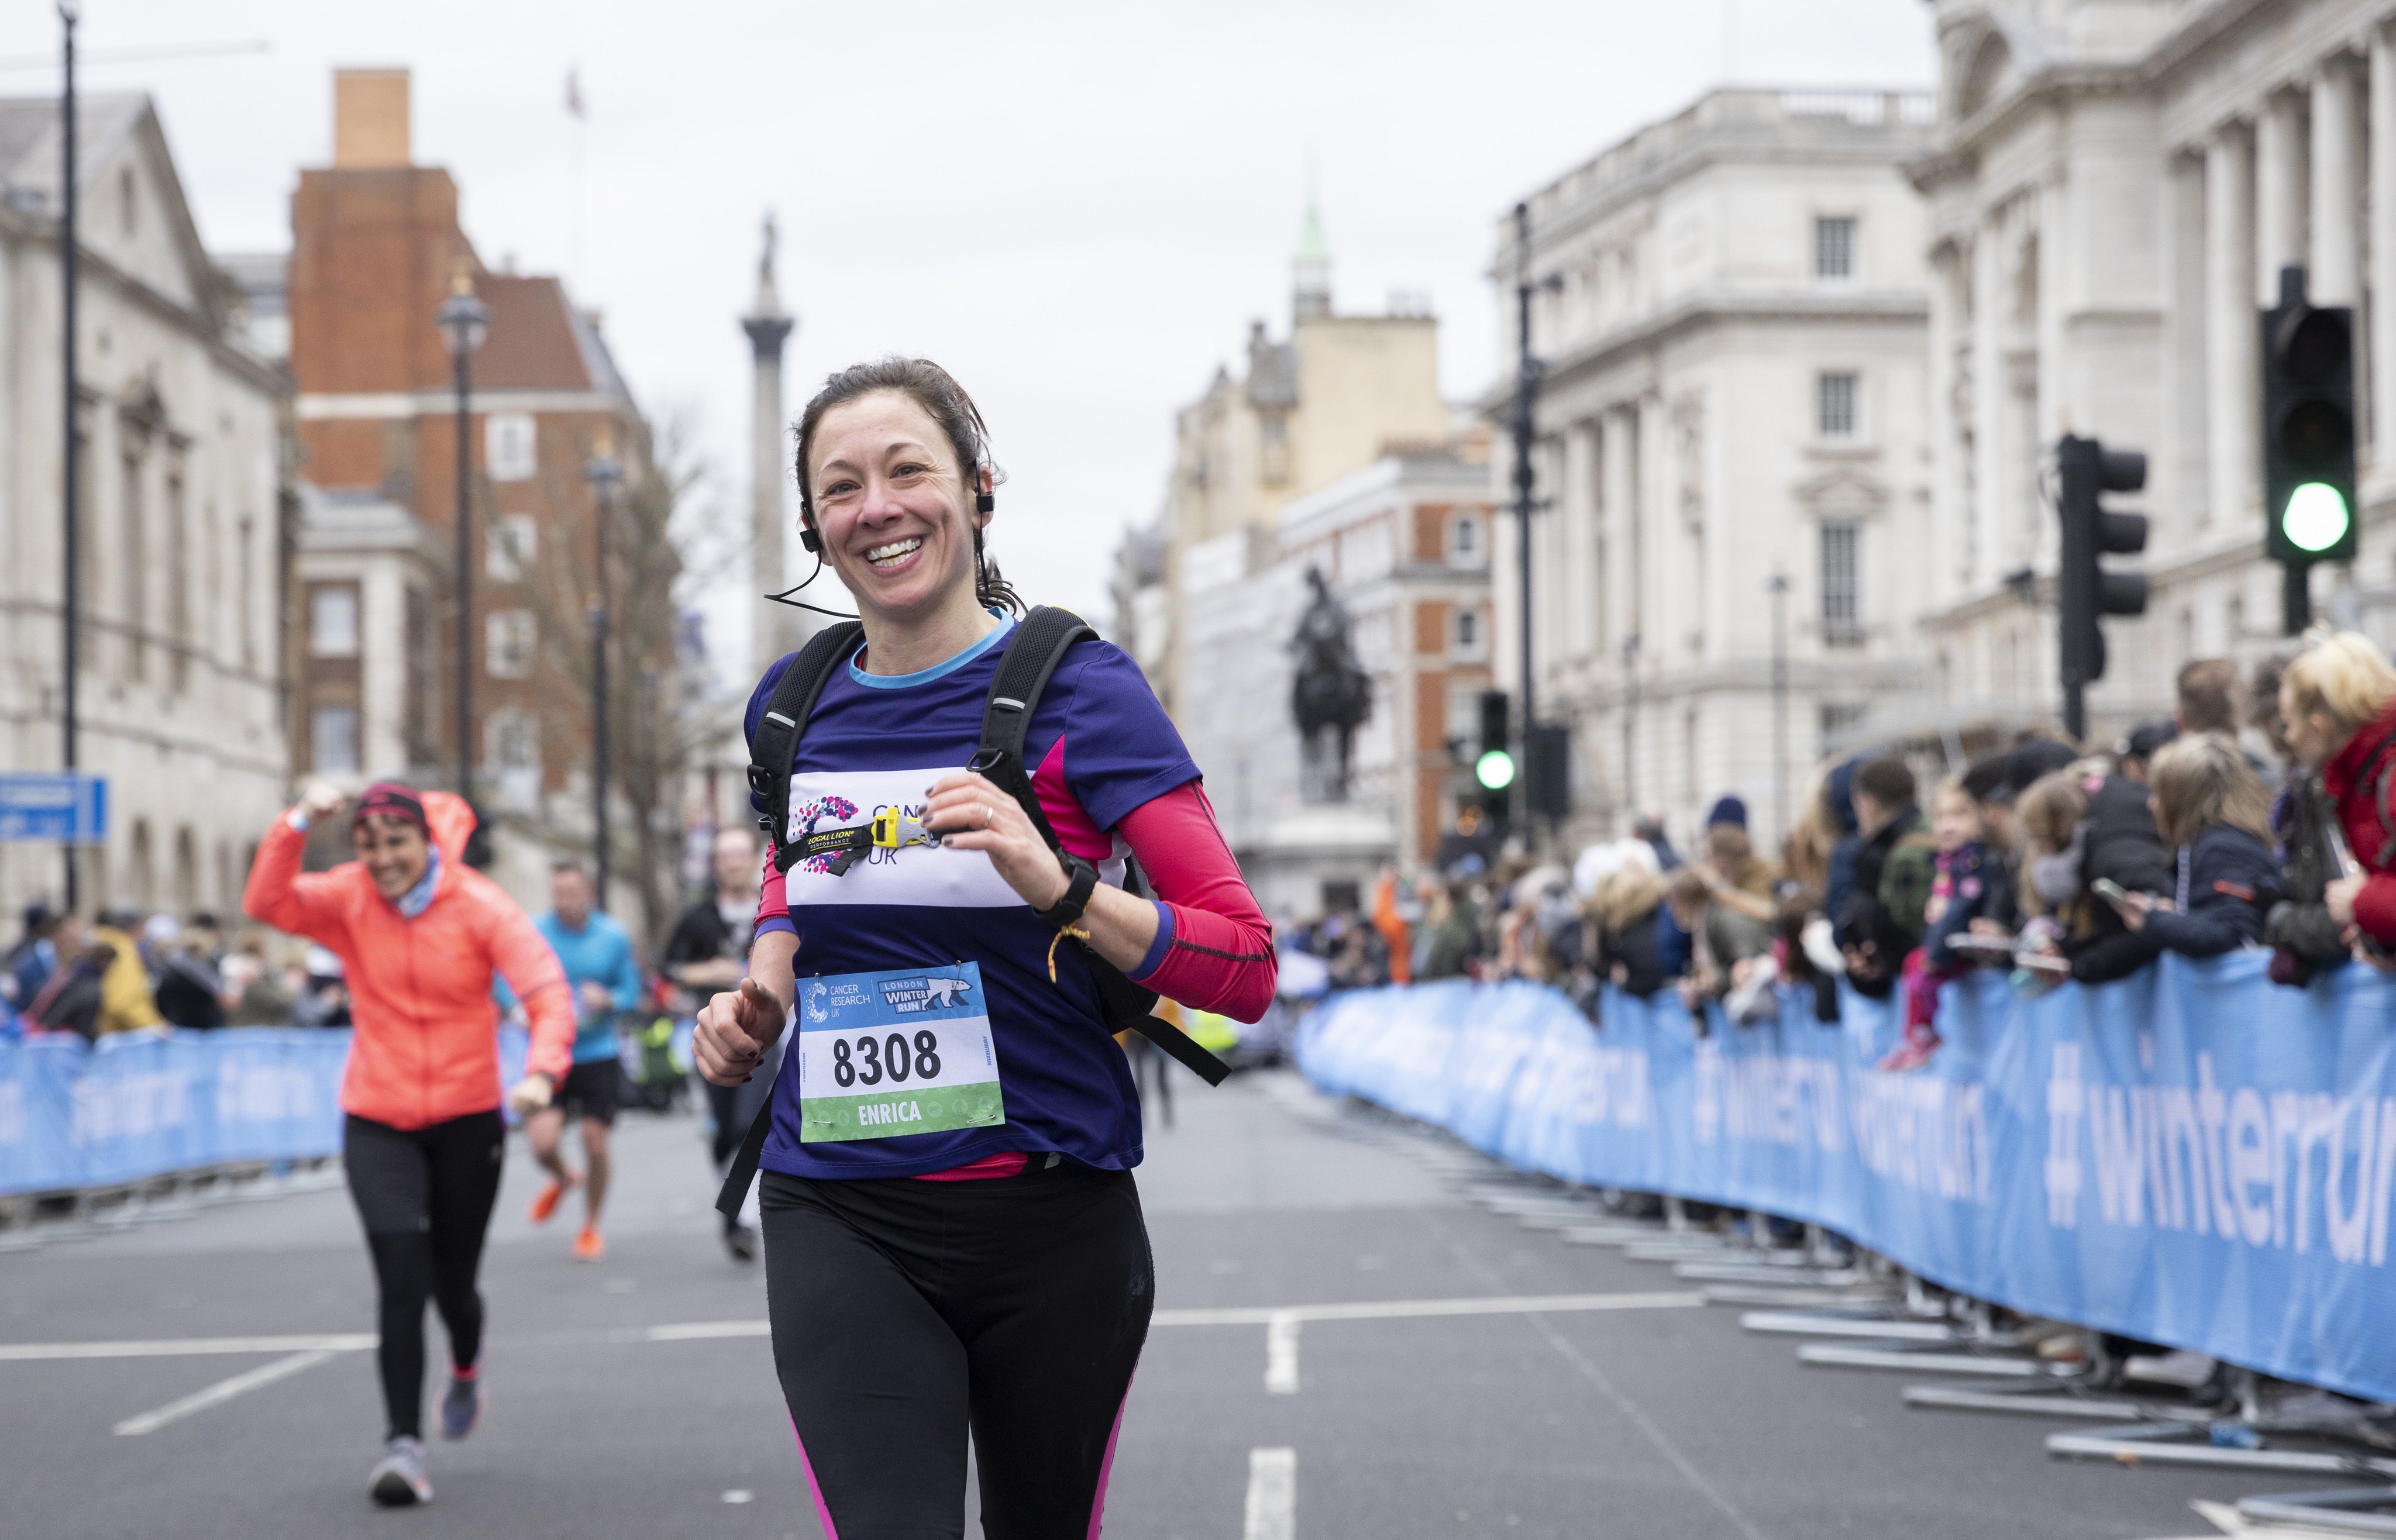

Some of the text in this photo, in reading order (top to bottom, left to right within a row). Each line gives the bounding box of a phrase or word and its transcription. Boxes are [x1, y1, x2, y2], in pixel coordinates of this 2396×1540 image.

[808, 834, 829, 845] LOCAL
[810, 838, 849, 849] PERFORMANCE
[868, 847, 898, 865] UK
[830, 984, 859, 995] CANCER
[884, 980, 924, 990] LONDON
[831, 994, 871, 1007] RESEARCH
[886, 990, 927, 1004] WINTER
[897, 1001, 920, 1012] RUN
[831, 1008, 840, 1018] UK
[833, 1029, 941, 1088] 8308
[858, 1100, 922, 1126] ENRICA
